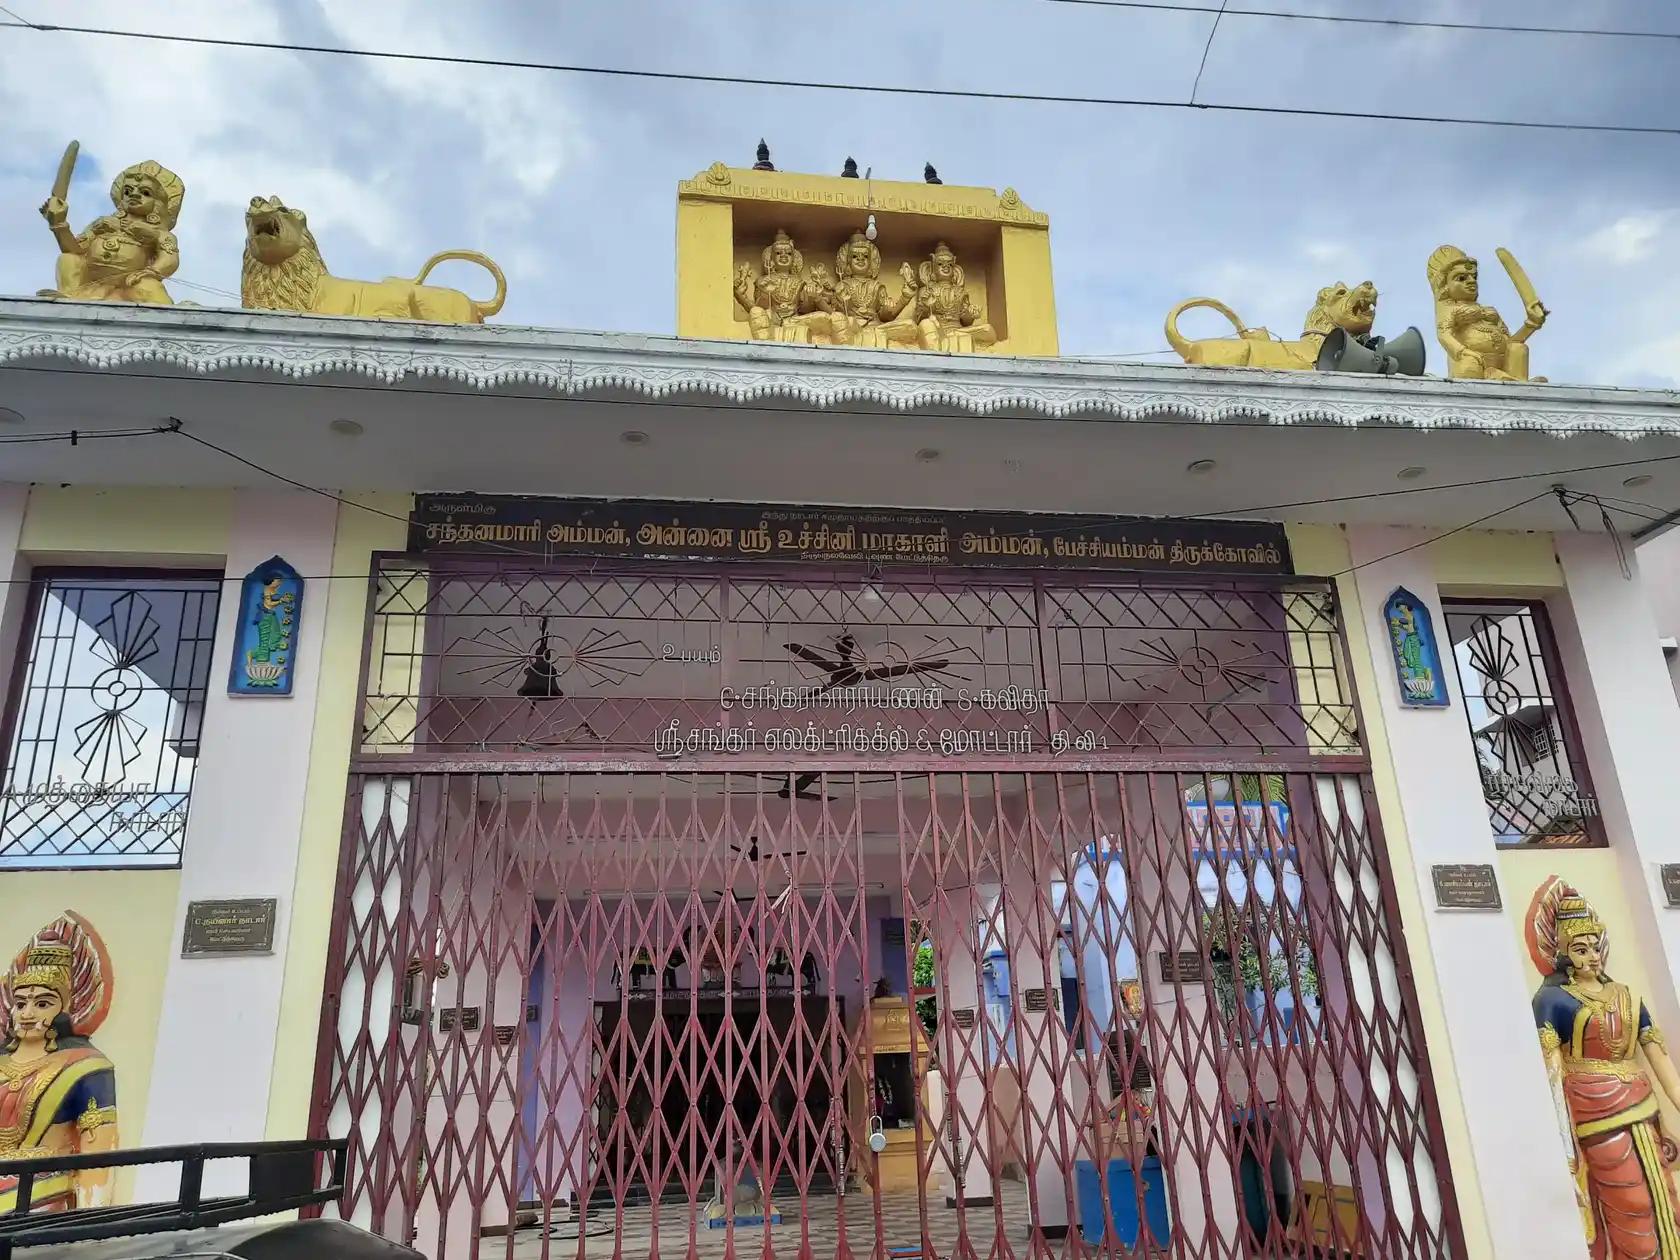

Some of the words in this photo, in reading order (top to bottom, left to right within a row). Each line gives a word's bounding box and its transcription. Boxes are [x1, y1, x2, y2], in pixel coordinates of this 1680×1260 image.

[426, 515, 542, 545] சந்தனமாரி
[546, 519, 631, 548] அம்மன்,
[636, 518, 732, 549] அன்னை
[739, 520, 772, 553] ஸ்ரீ
[778, 521, 856, 551] உச்சினி
[861, 526, 950, 554] மாகாளி
[958, 526, 1049, 558] அம்மன்,
[1053, 535, 1165, 561] பேச்சியம்மன்
[1169, 538, 1282, 566] திருக்கோவில்
[916, 728, 934, 753] &
[939, 723, 1032, 755] மோட்டார்
